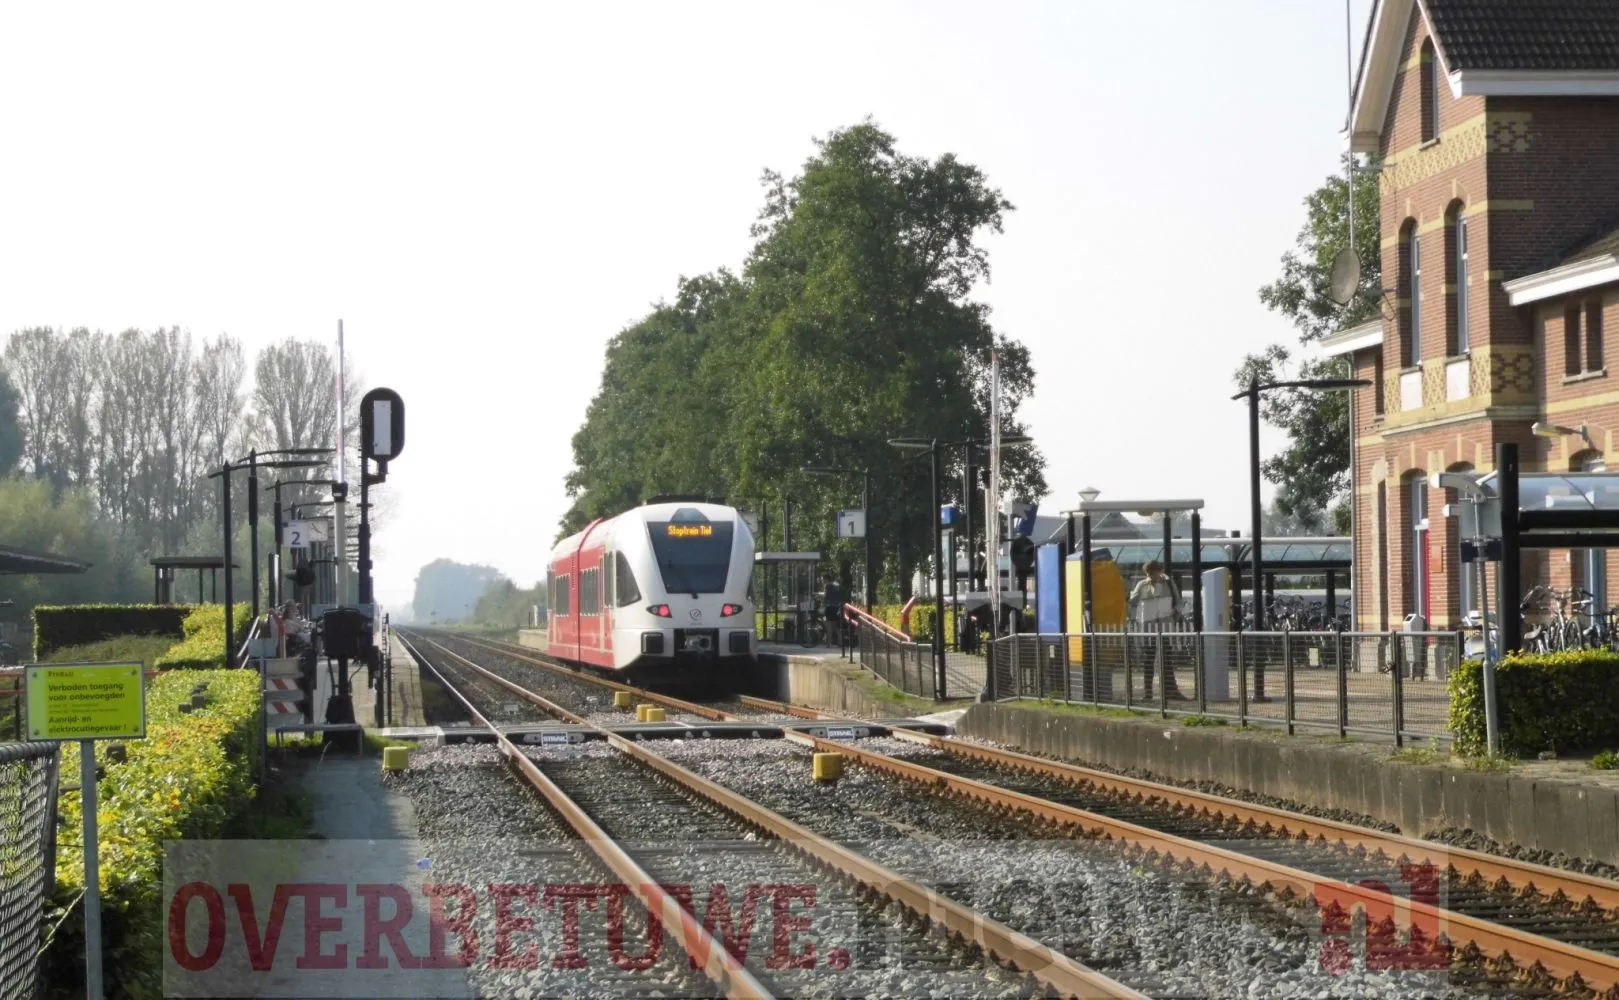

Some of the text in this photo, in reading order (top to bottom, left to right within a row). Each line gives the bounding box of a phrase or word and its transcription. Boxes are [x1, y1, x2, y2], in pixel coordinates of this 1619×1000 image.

[848, 521, 855, 535] 1
[291, 531, 301, 545] 2
[48, 682, 124, 691] Verboden toegang
[69, 692, 125, 701] onbevoegden
